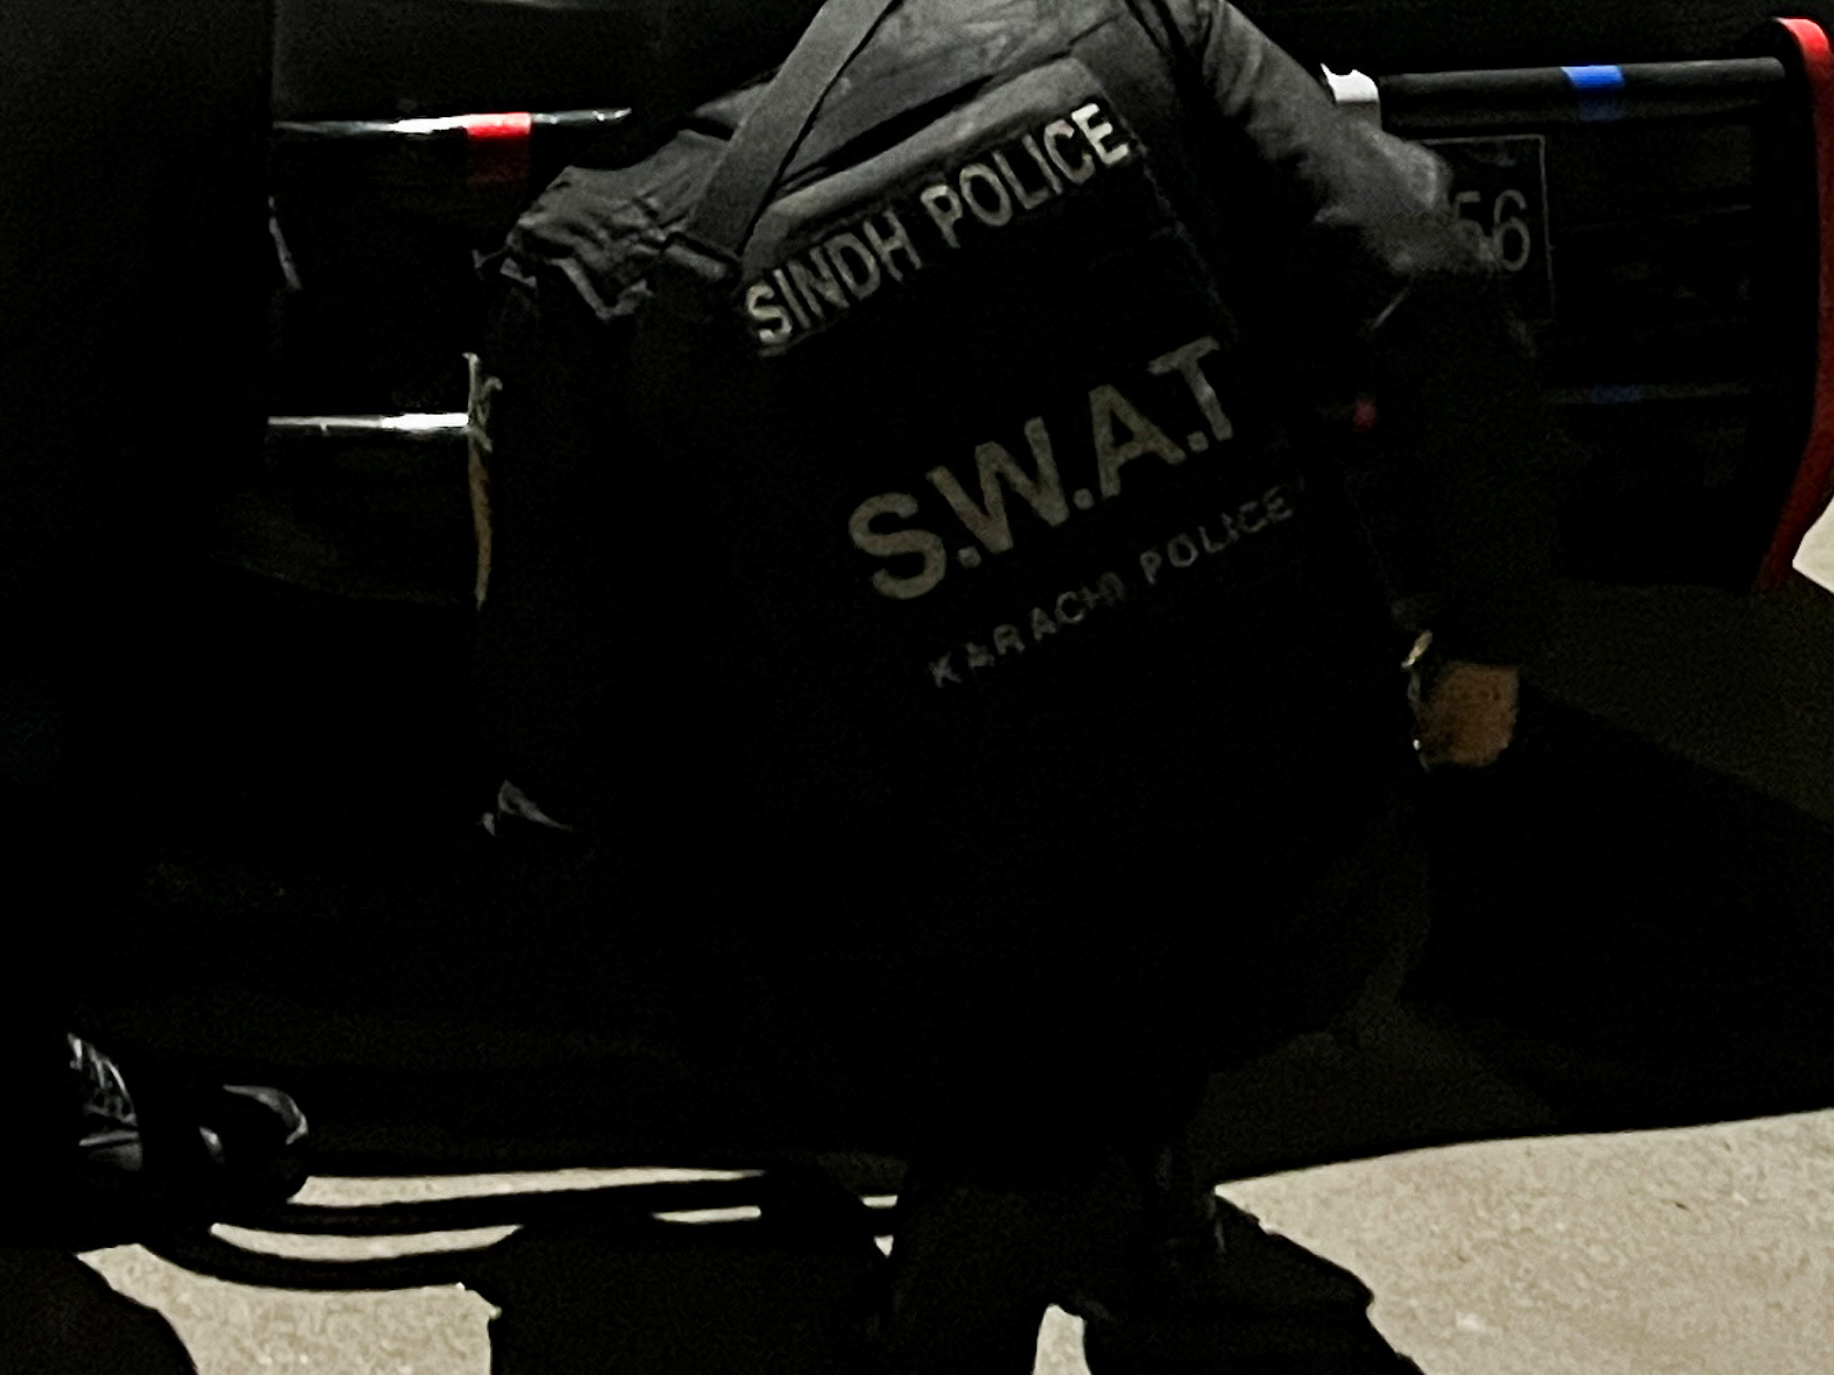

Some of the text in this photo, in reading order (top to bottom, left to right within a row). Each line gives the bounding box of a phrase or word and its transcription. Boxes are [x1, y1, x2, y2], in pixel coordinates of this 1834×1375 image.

[744, 102, 1133, 346] SINDH POLICE
[846, 336, 1235, 602] S.W.A.T
[928, 484, 1295, 689] KARACHI POLICE
